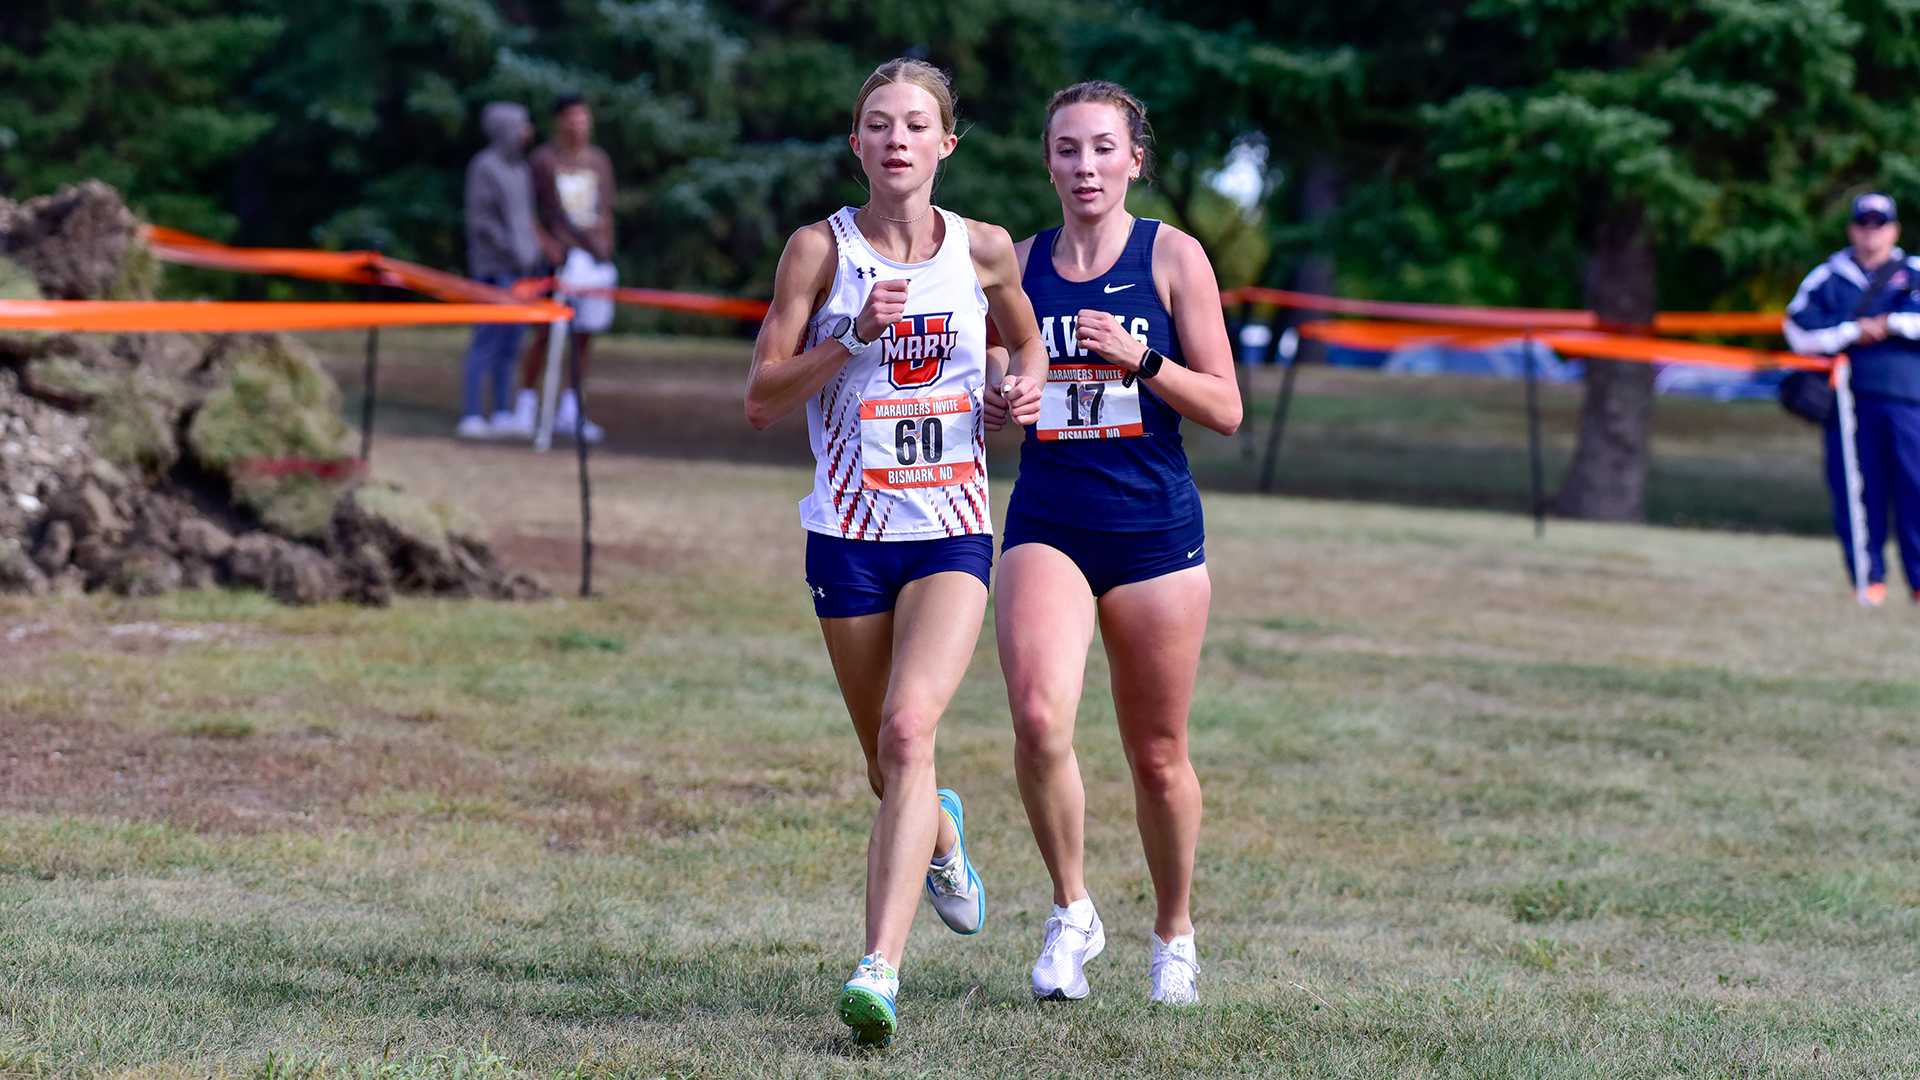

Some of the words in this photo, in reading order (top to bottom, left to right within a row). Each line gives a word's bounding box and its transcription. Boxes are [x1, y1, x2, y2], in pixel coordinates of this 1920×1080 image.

[882, 331, 957, 364] MARY
[1047, 369, 1093, 380] MARAUDERS
[1095, 369, 1123, 379] INVITE
[875, 402, 931, 417] MARAUDERS
[932, 399, 959, 414] INVITE
[1066, 383, 1105, 426] 17
[895, 417, 943, 465] 60
[888, 467, 937, 484] BISMARK,
[939, 466, 953, 480] ND
